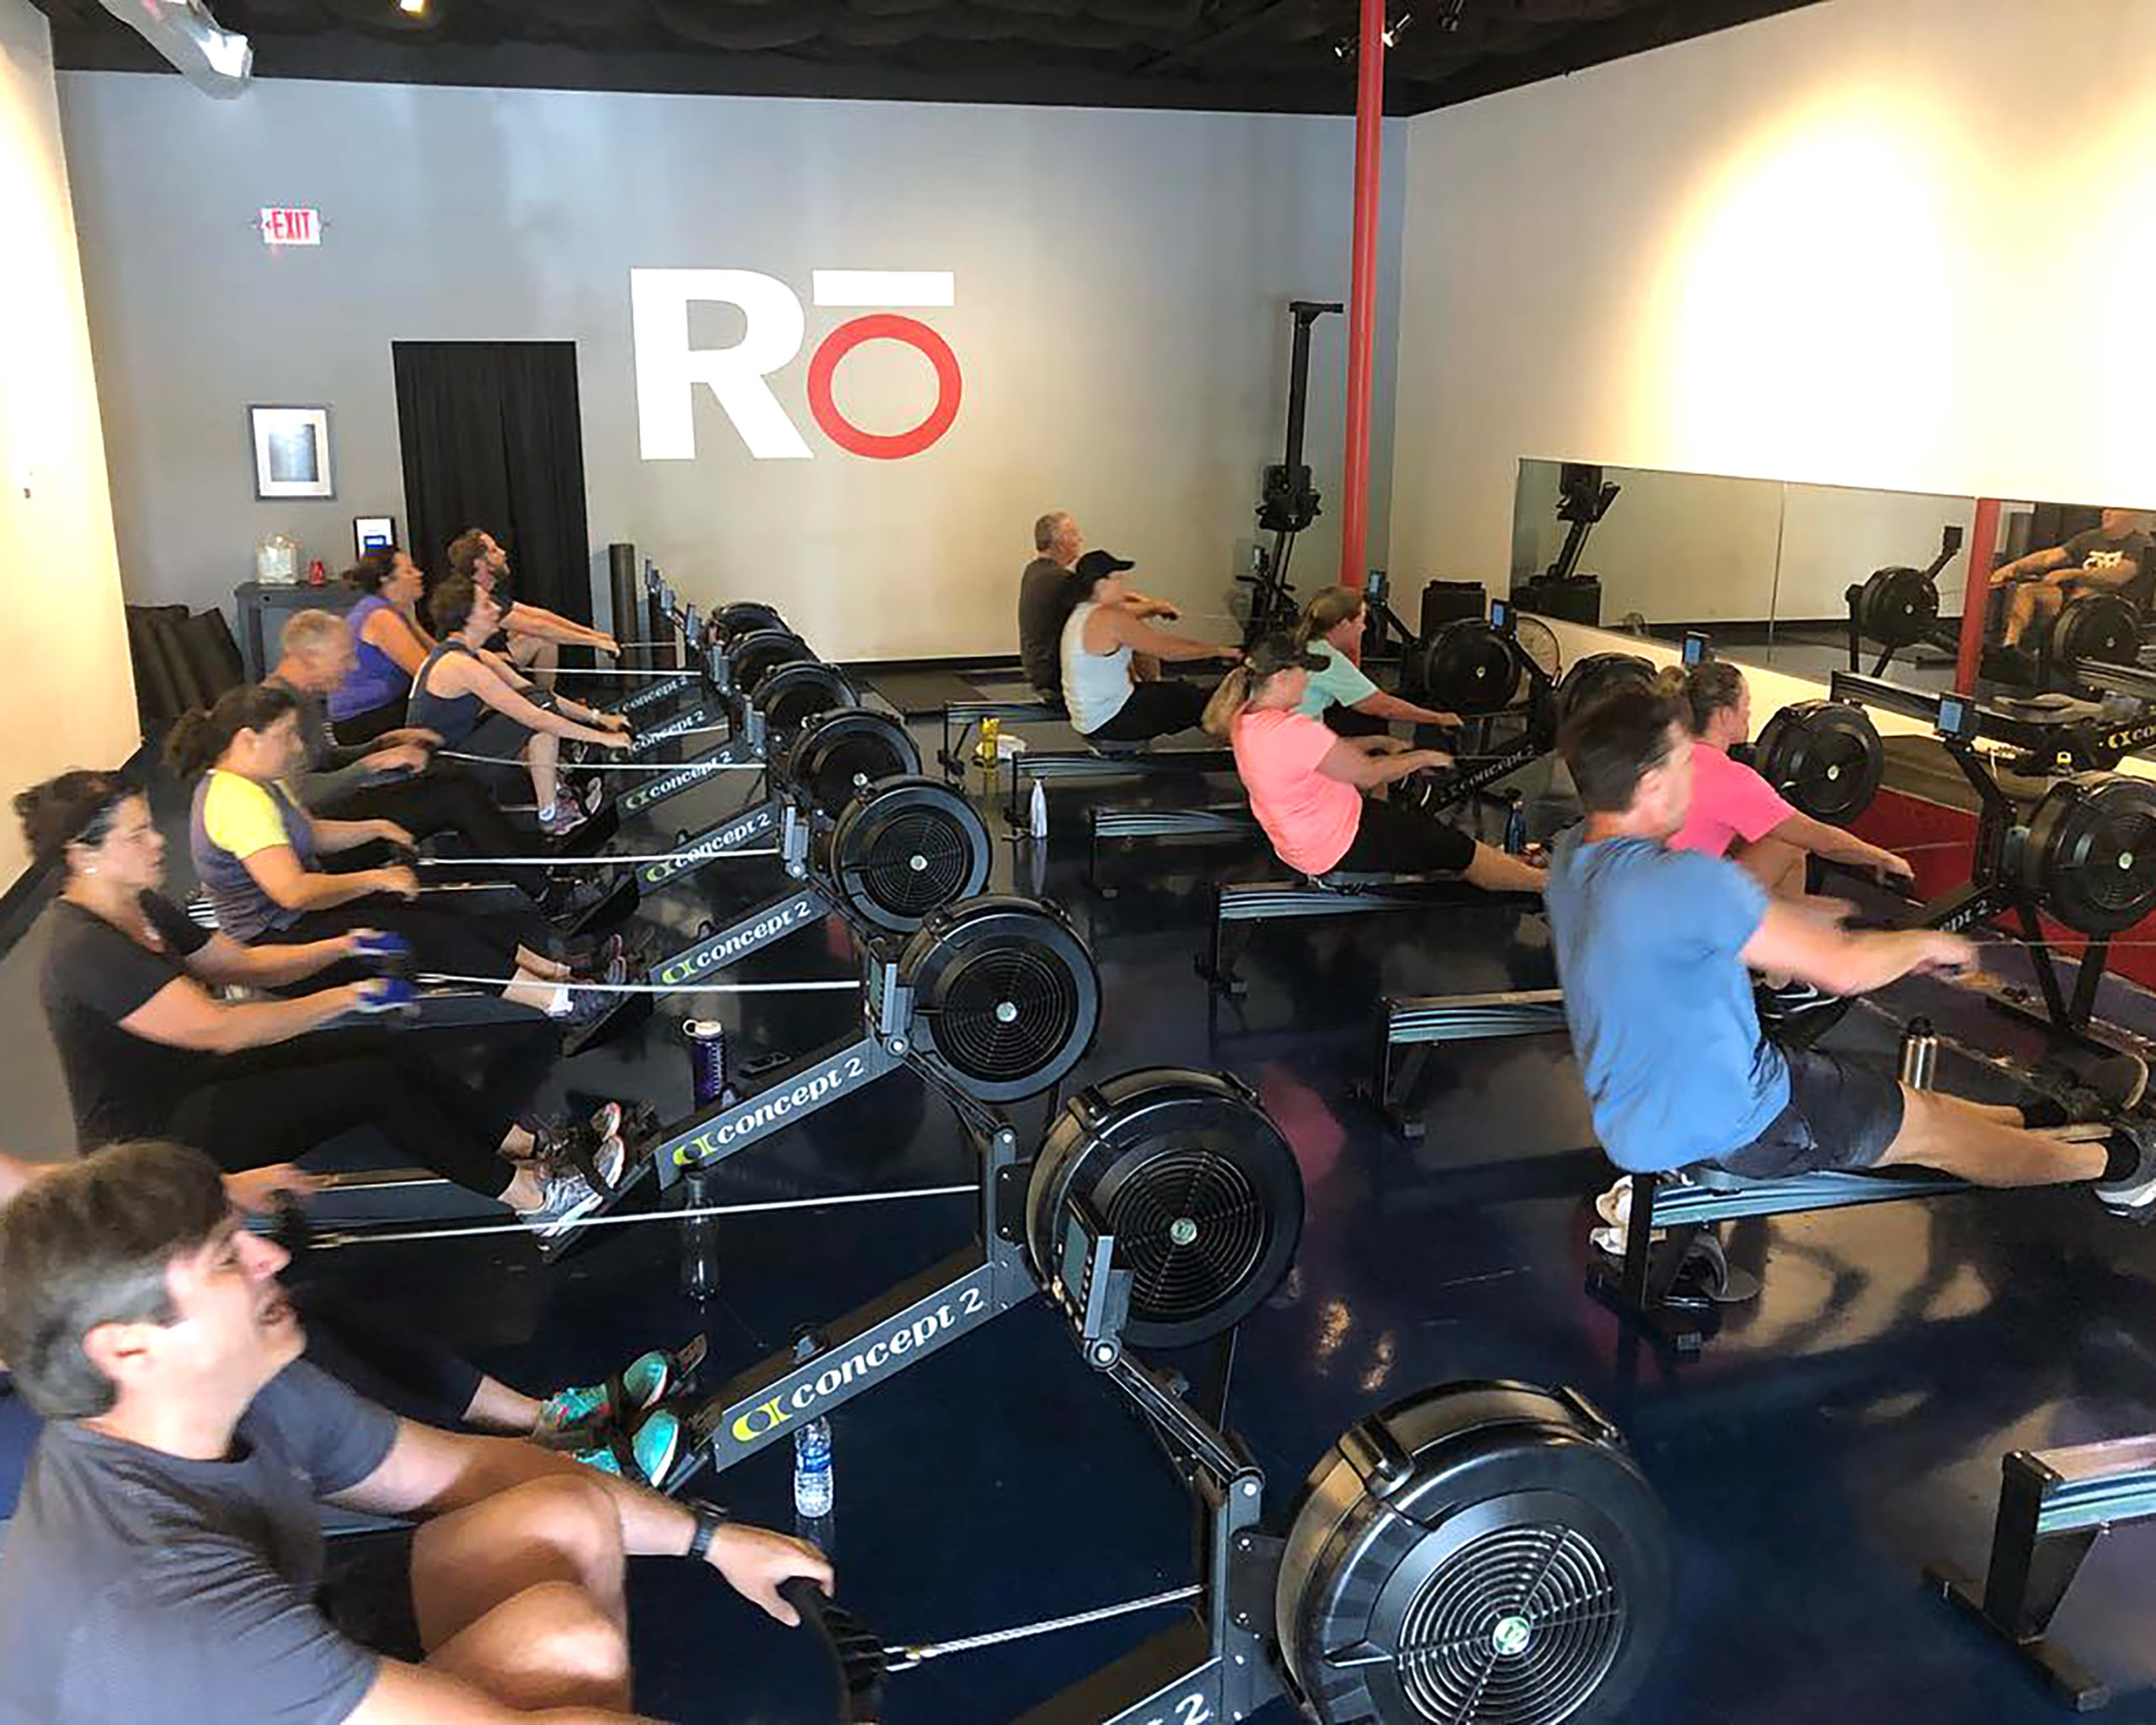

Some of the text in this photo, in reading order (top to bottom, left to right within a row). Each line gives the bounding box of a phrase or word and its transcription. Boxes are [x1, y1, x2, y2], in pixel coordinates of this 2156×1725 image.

[271, 210, 310, 240] EXIT
[622, 676, 688, 713] concept 2
[632, 710, 707, 752] concept 2
[648, 750, 734, 798] concept 2
[674, 813, 771, 868] concept 2
[696, 901, 812, 968] concept 2
[717, 1057, 864, 1146] concept 2
[792, 1288, 985, 1408] concept 2
[1175, 1693, 1210, 1725] 2
